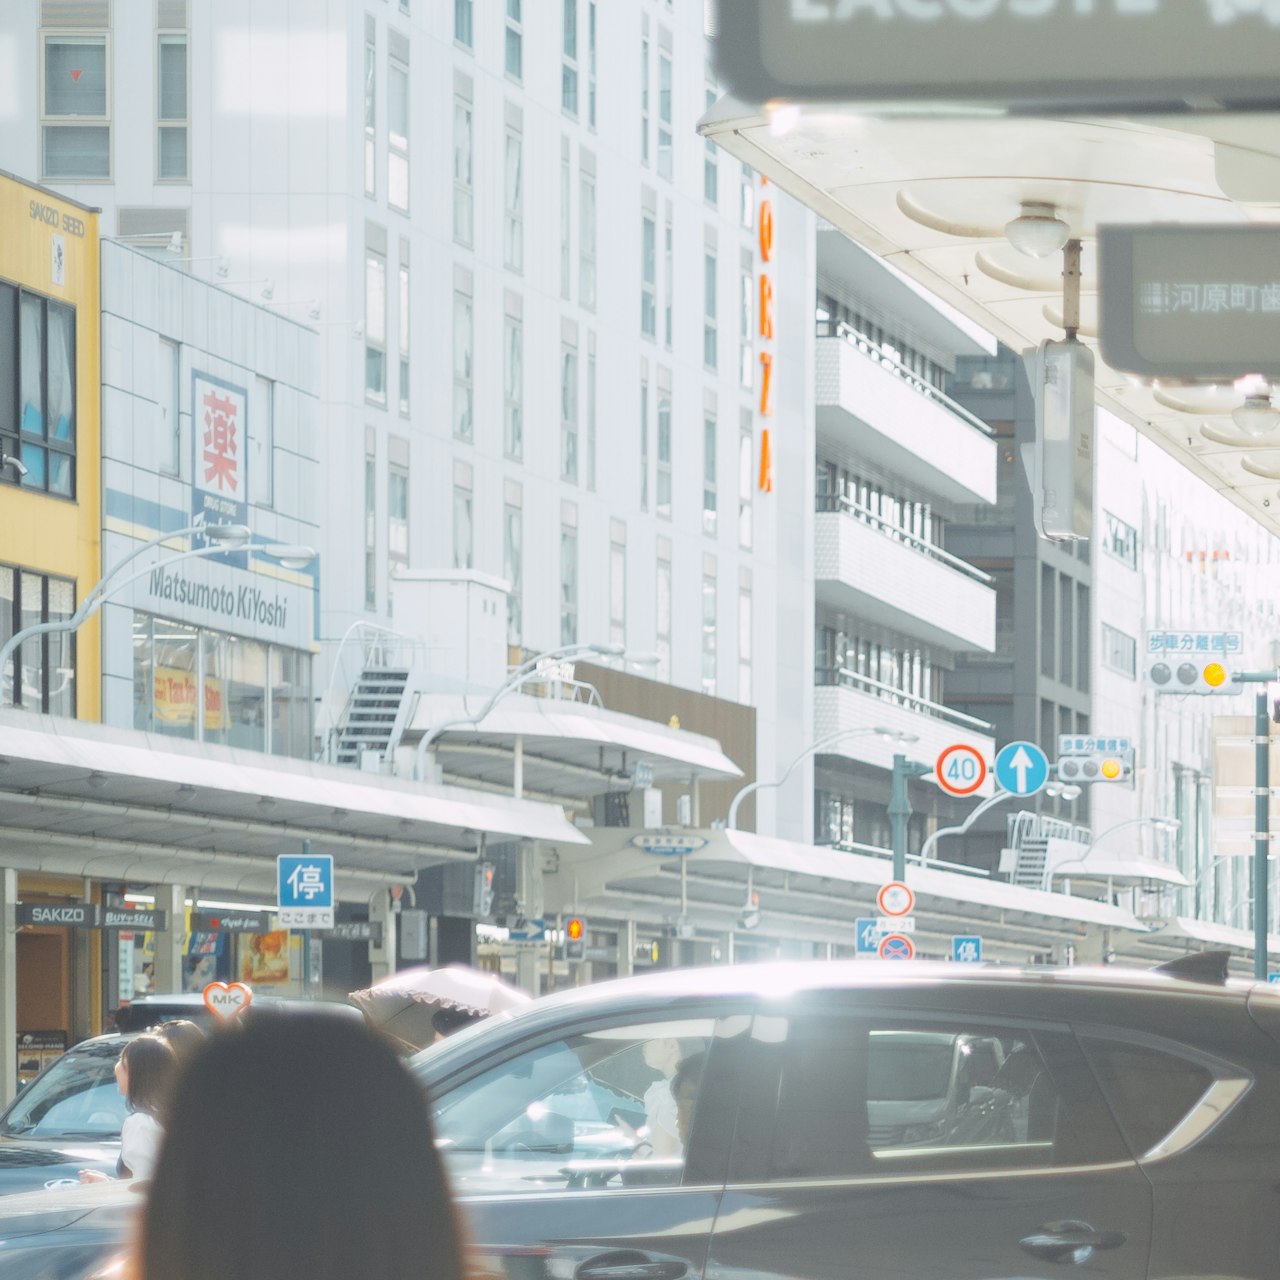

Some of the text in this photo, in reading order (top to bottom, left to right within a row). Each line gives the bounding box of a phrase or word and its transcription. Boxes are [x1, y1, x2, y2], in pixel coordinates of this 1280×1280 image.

[759, 176, 774, 493] ORZA
[203, 390, 238, 493] 薬
[150, 562, 287, 629] Matsumoto KiYoshi
[1149, 634, 1240, 651] 歩車分離信号
[1063, 738, 1129, 751] 歩車分離信号
[948, 757, 976, 780] 40
[287, 864, 324, 900] 停
[32, 908, 84, 922] SAKIZO
[281, 912, 332, 924] ここまで
[213, 994, 241, 1004] MK
